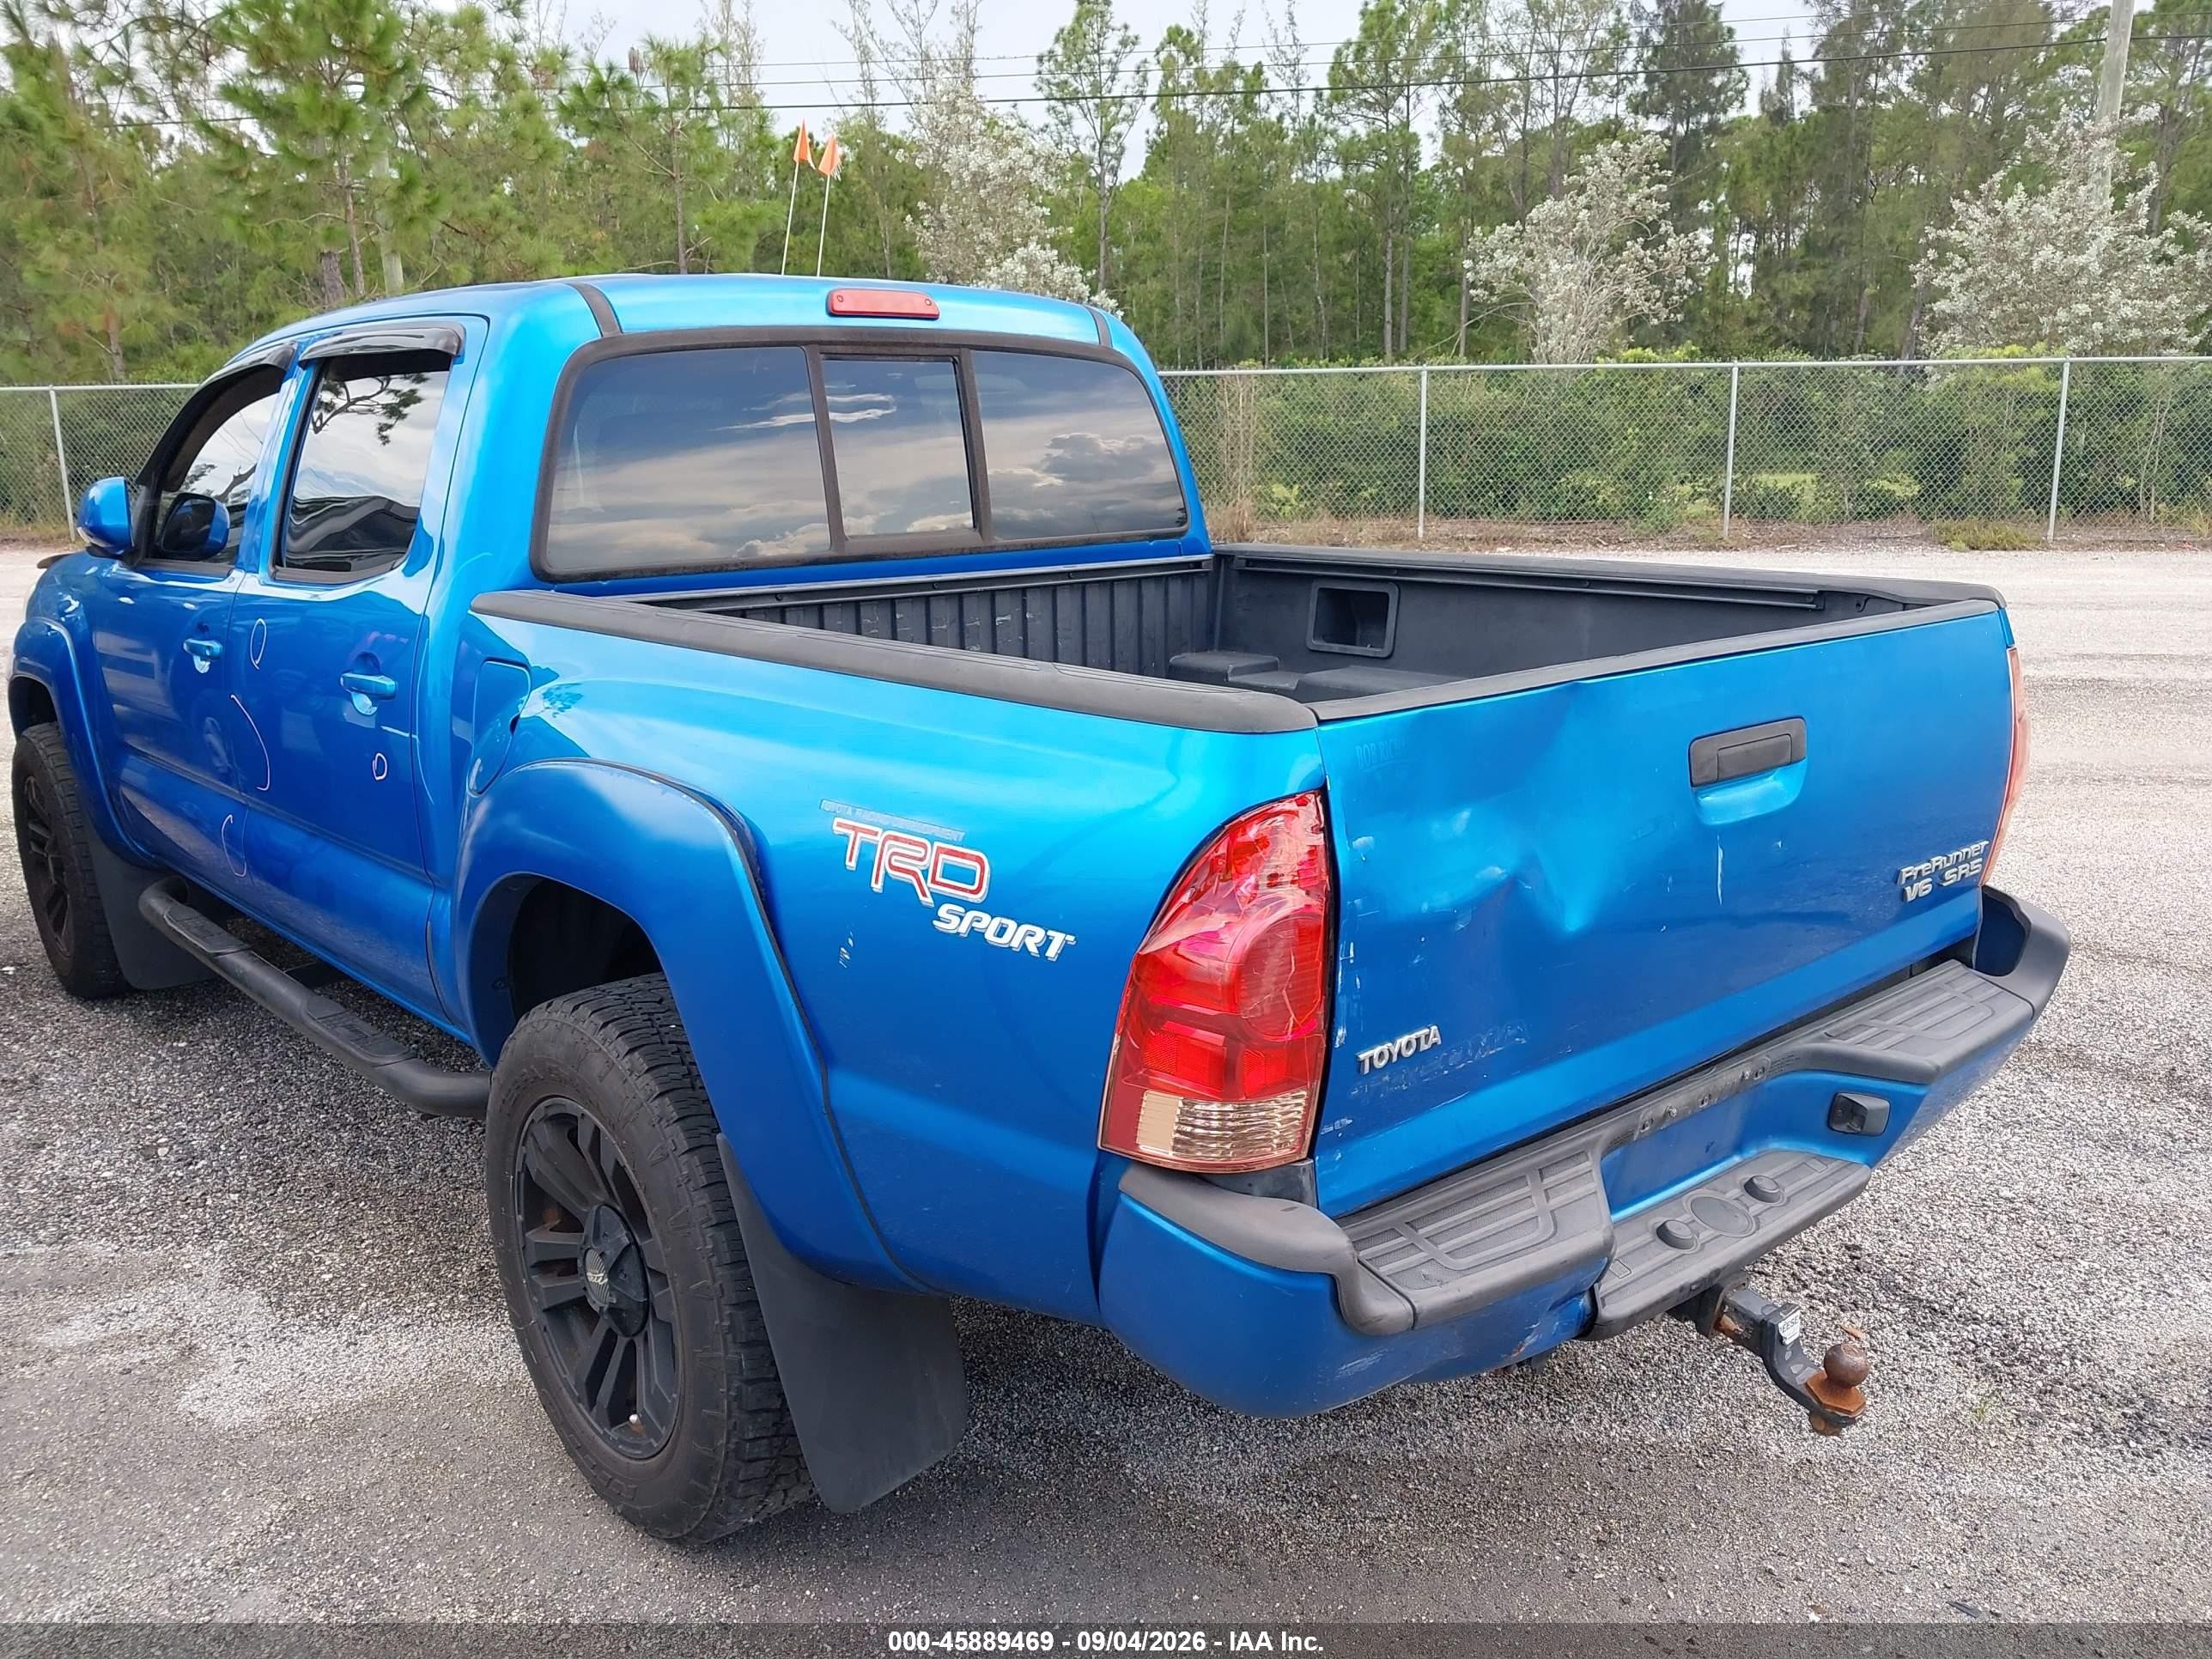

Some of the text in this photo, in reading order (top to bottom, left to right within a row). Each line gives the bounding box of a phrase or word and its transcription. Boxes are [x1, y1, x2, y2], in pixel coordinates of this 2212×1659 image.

[832, 817, 990, 907] TRD
[1903, 858, 1983, 902] V6 SR5
[933, 902, 1077, 962] SPORT
[1356, 1024, 1443, 1075] TOYOTA
